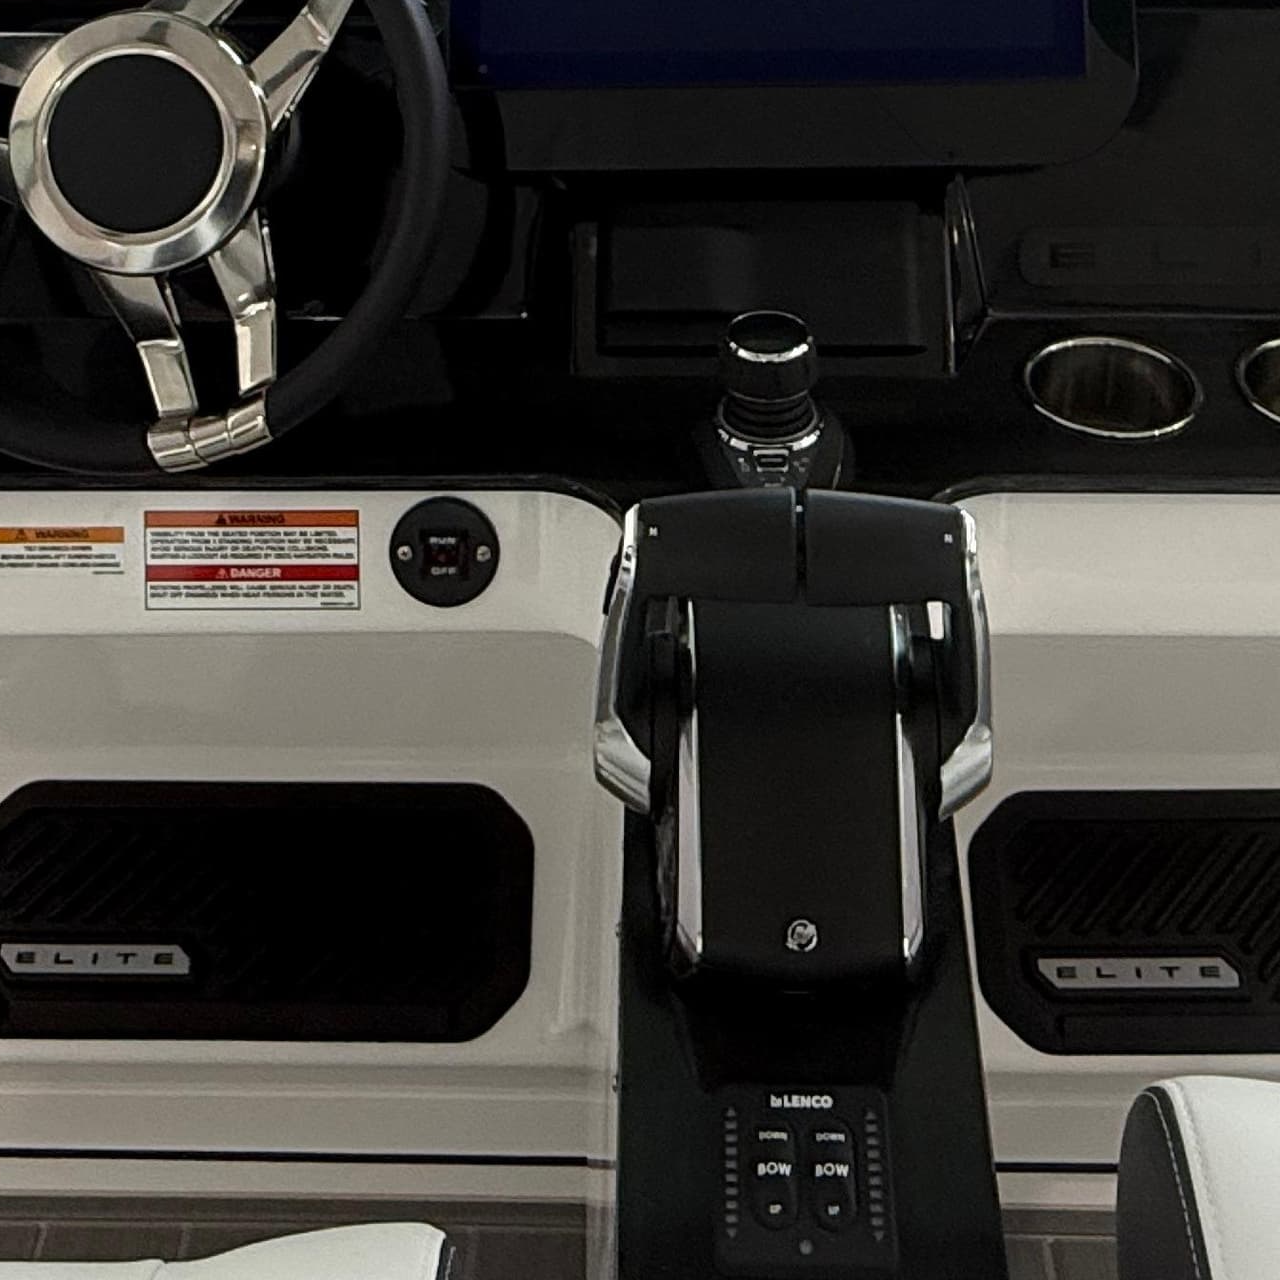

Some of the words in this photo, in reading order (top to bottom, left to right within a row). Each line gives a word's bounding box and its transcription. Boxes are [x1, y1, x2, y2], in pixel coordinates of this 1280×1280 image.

[227, 514, 285, 524] WARNING
[429, 536, 457, 545] RUN
[229, 567, 282, 579] DANGER
[430, 566, 457, 575] OFF
[15, 951, 174, 965] ELITE
[1055, 965, 1221, 979] ELITE
[757, 1162, 792, 1176] BOW
[815, 1162, 849, 1178] BOW
